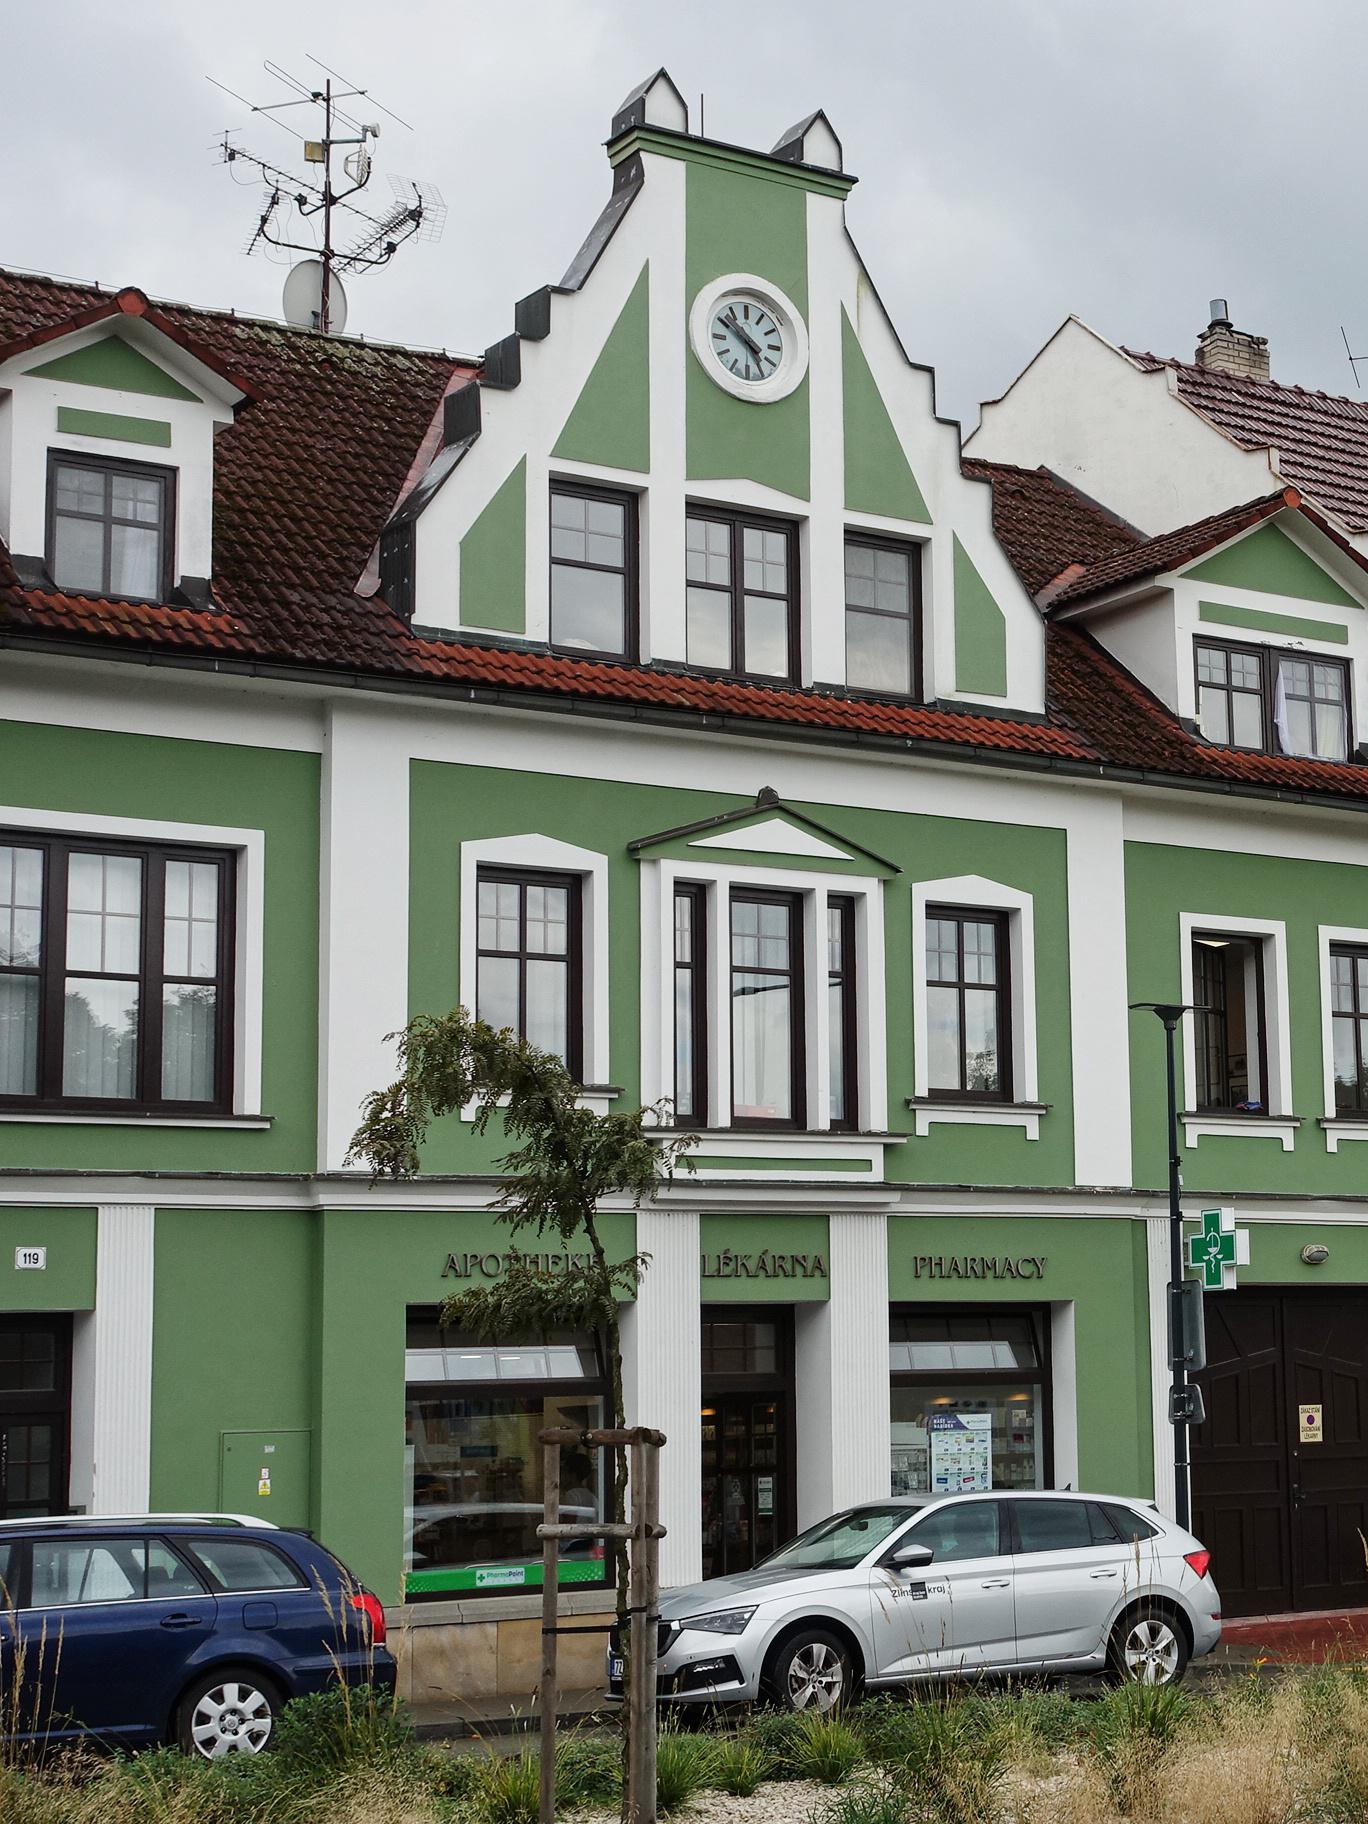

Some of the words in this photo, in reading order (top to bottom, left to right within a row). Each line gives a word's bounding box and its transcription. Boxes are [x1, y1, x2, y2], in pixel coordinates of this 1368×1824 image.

[23, 1252, 39, 1265] 119
[701, 1249, 828, 1278] LÉKÁRNA
[914, 1255, 1047, 1279] PHARMACY
[927, 1584, 946, 1595] kraj
